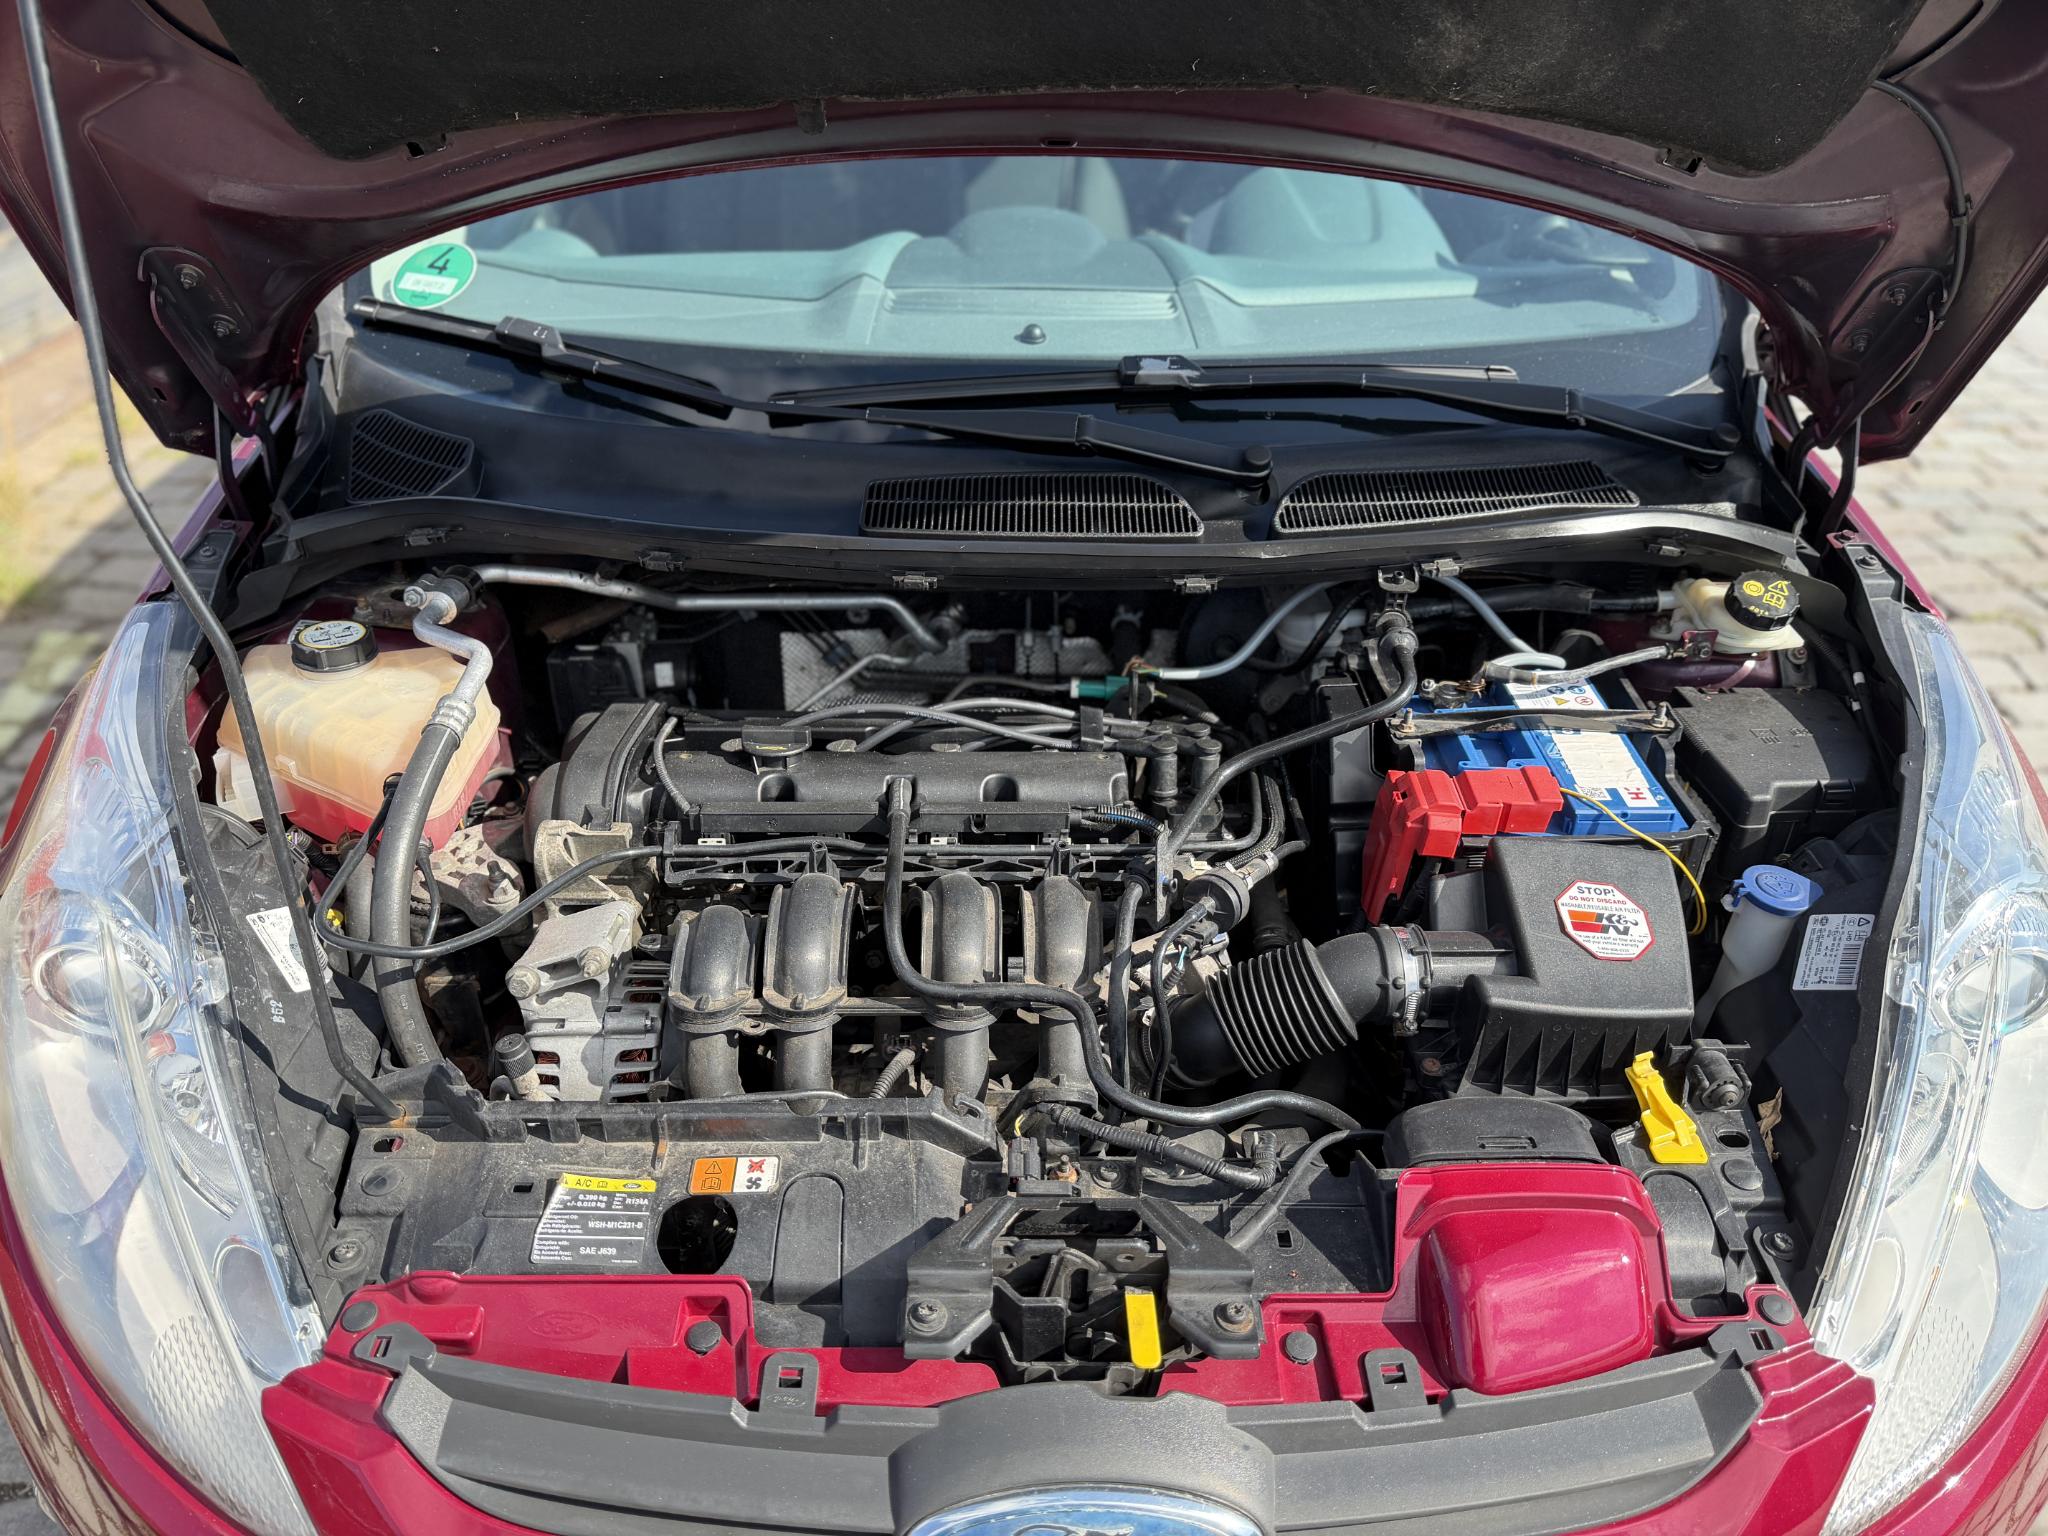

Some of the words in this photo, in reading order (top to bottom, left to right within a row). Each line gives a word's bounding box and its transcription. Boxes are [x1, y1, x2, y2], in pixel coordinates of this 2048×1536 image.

[427, 246, 454, 275] 4
[1576, 886, 1616, 897] STOP!
[1596, 897, 1627, 905] DISCARD
[1845, 930, 1854, 942] LHD
[575, 1178, 592, 1188] A/C
[579, 1246, 597, 1255] SAE
